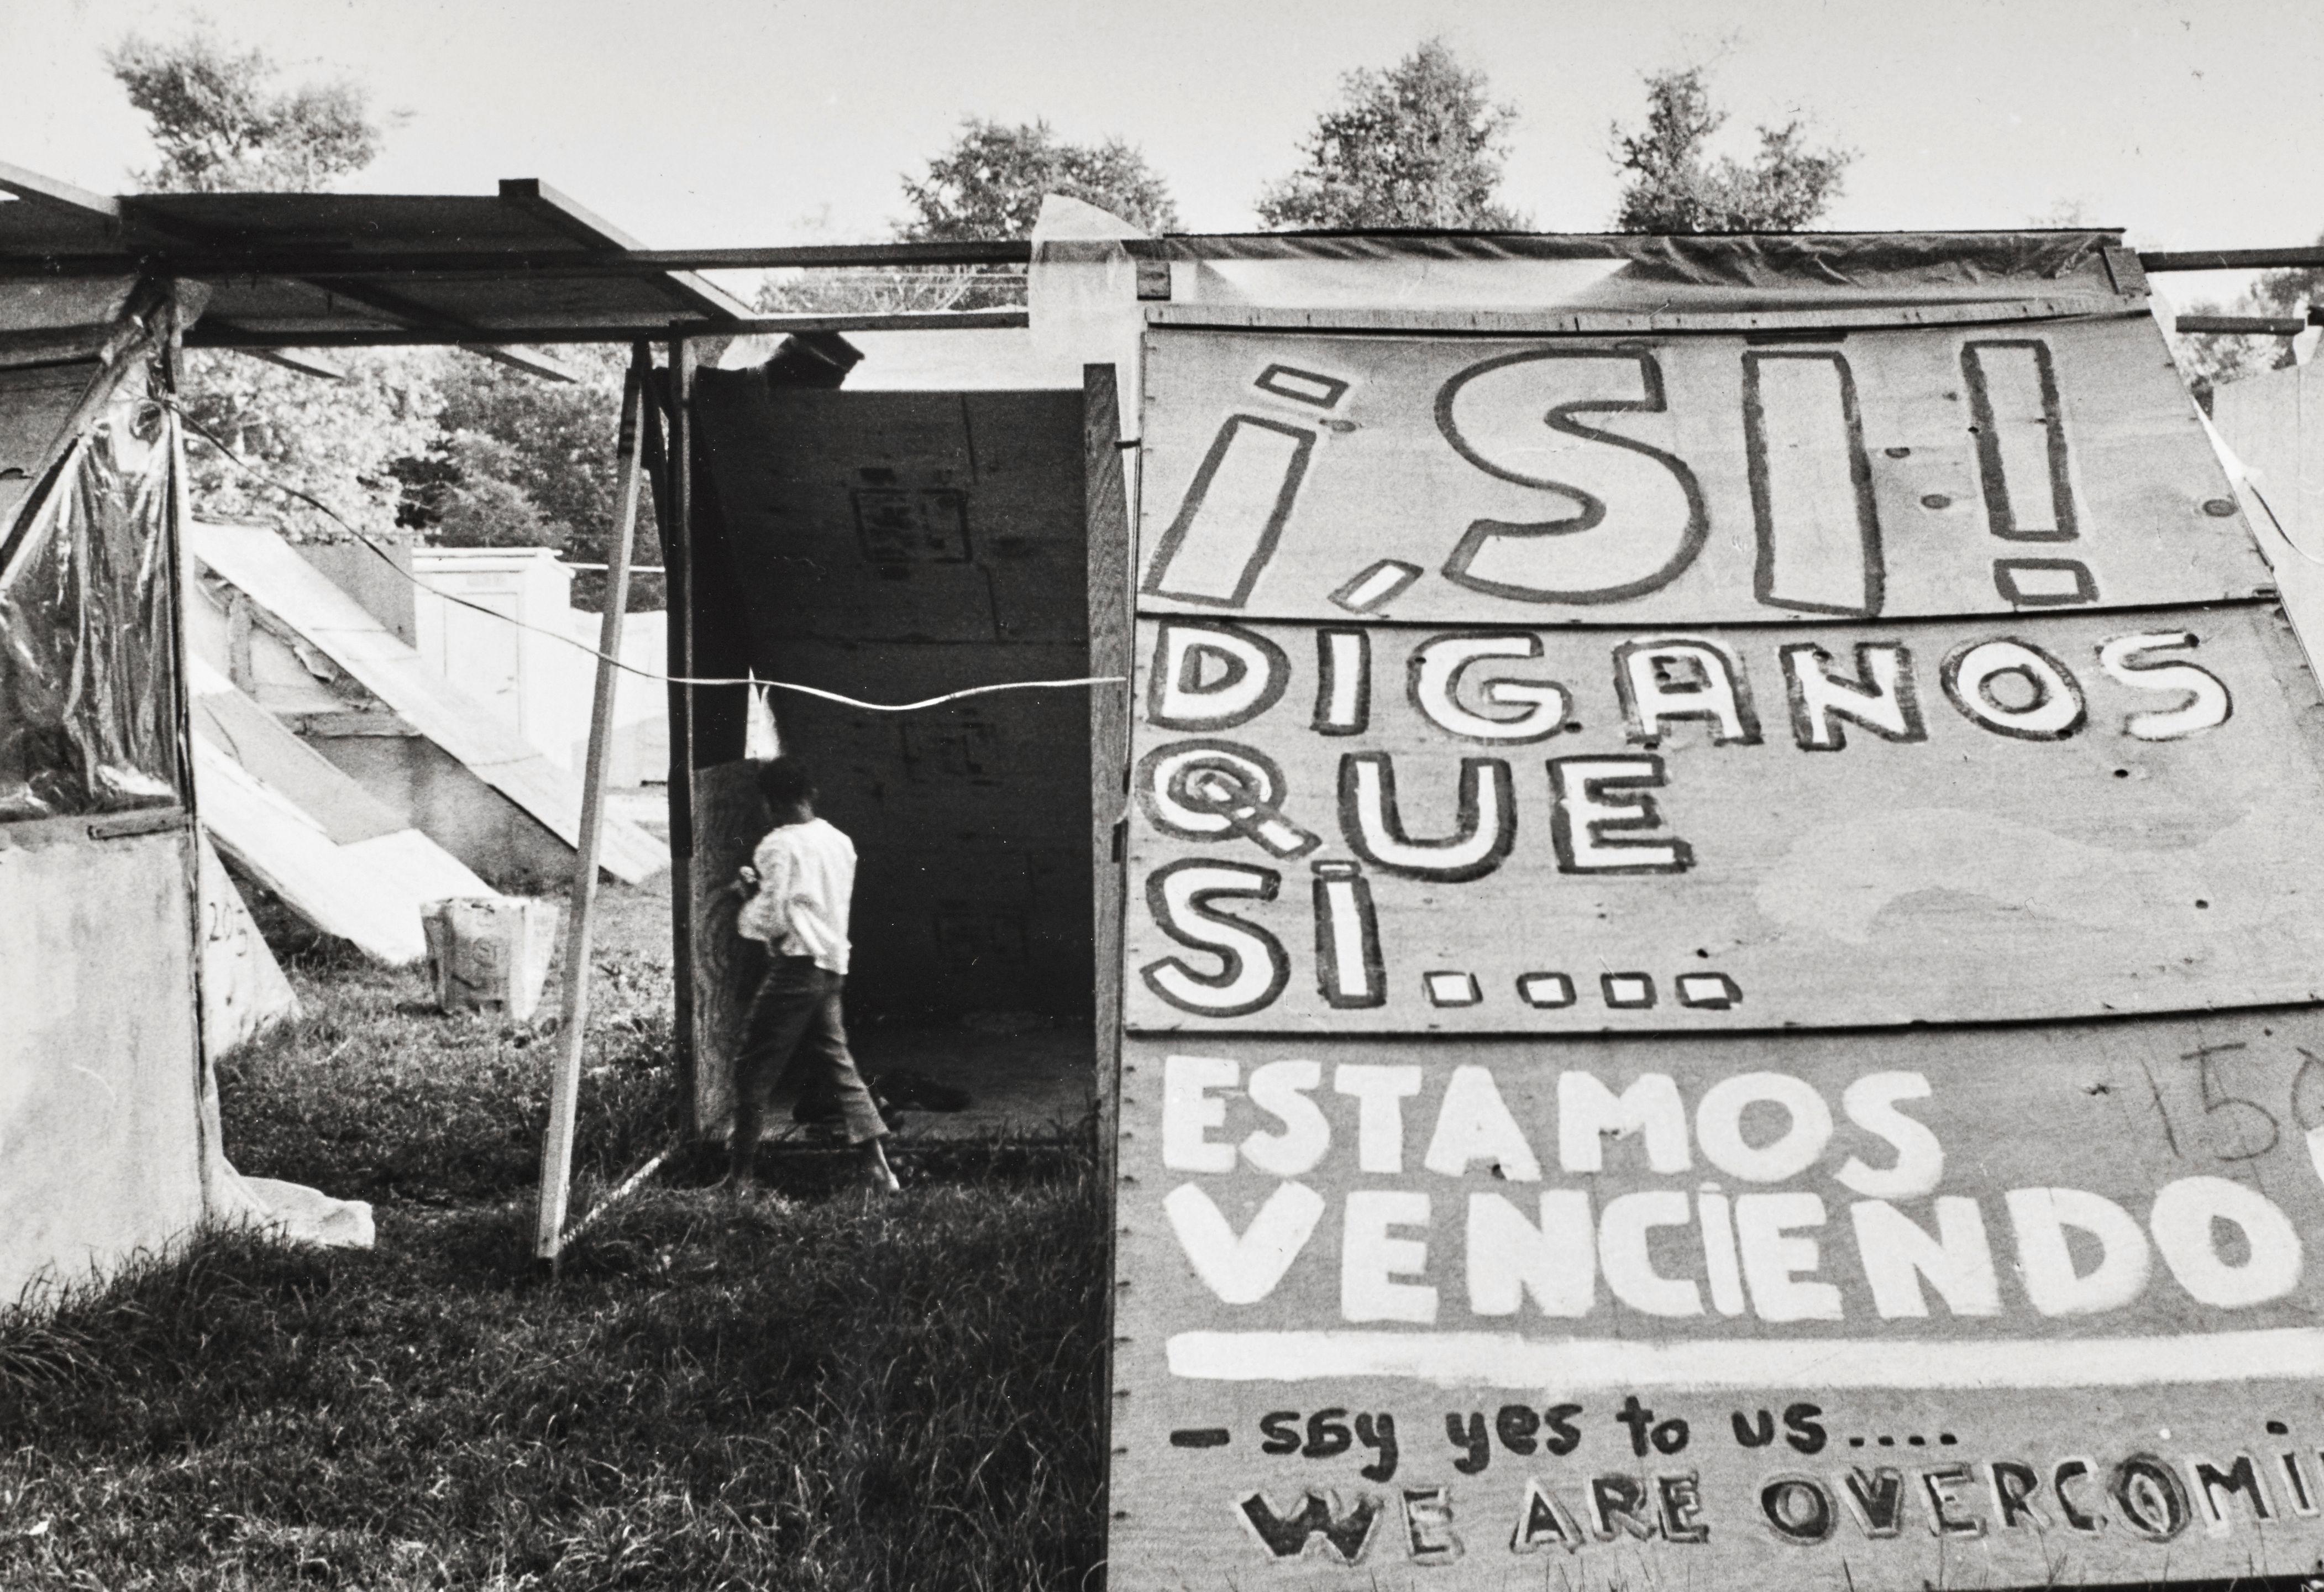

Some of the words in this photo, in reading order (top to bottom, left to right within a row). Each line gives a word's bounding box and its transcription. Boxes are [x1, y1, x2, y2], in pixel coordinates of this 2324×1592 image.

[1147, 617, 2233, 750] DIGANOS
[1135, 738, 1695, 882] QUE
[1162, 1055, 1945, 1198] ESTAMOS
[1259, 1407, 1398, 1483] say
[1444, 1404, 1583, 1474] yes
[1616, 1395, 1689, 1457] to
[1235, 1487, 1465, 1567] WE
[1508, 1470, 1709, 1556] ARE
